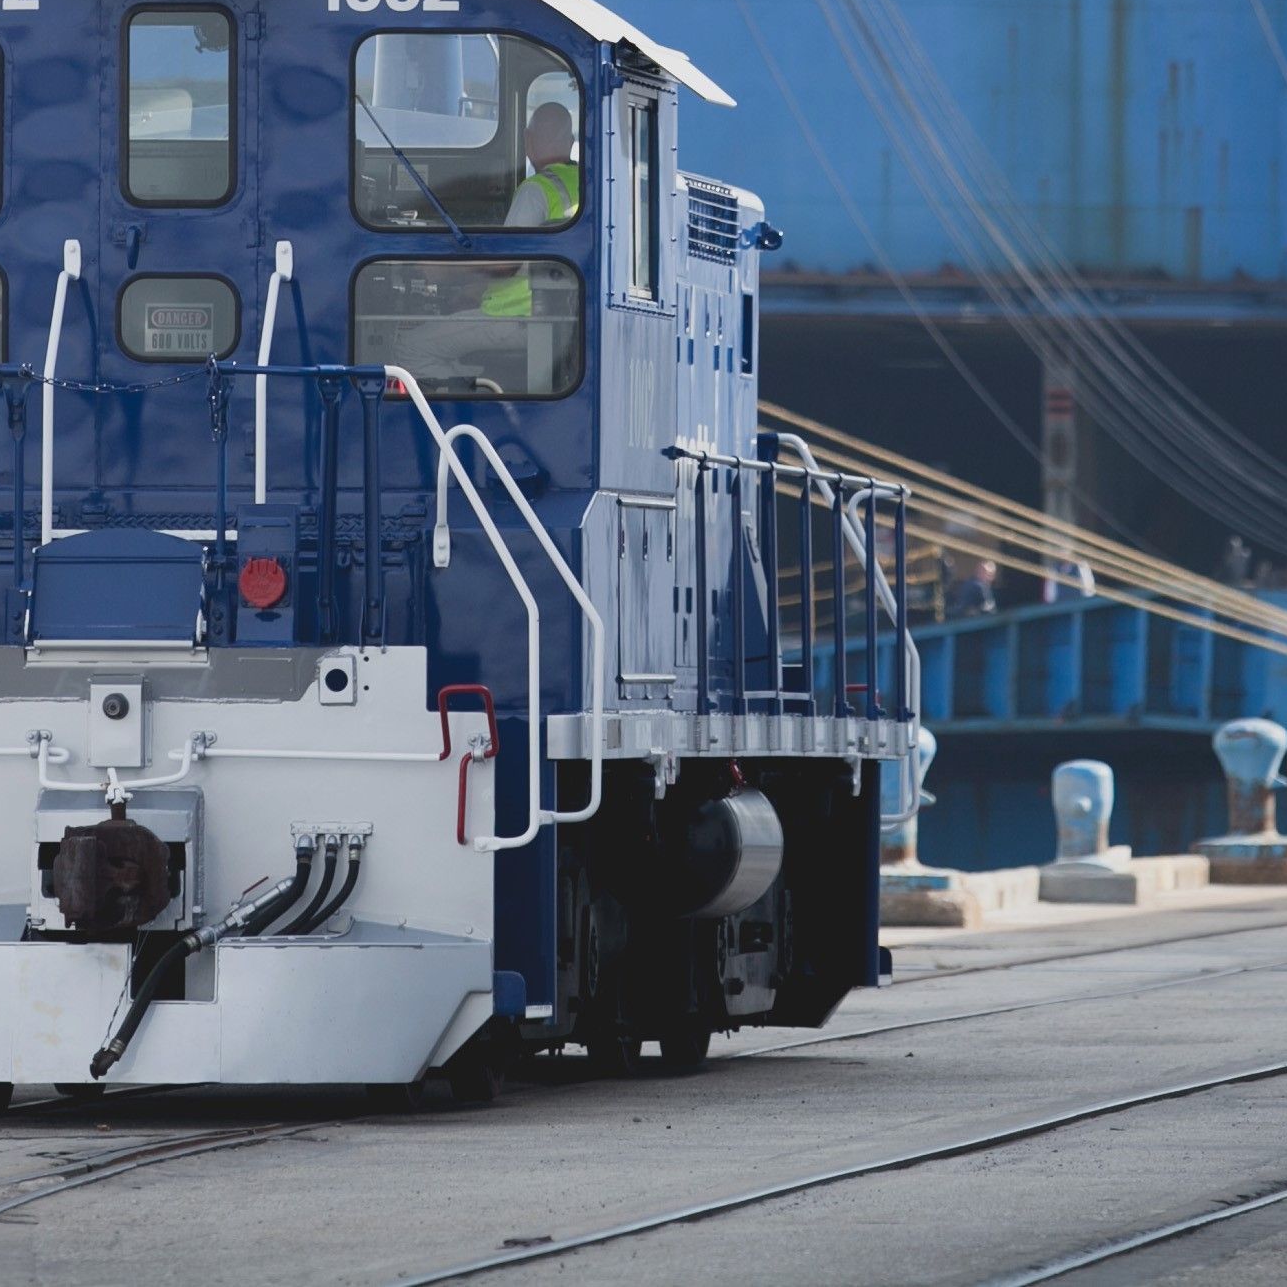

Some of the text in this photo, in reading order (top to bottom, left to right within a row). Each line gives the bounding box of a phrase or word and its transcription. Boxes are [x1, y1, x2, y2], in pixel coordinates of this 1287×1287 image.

[156, 310, 203, 325] DANGER
[151, 333, 207, 350] 600 VOLTS
[628, 358, 655, 449] 1002
